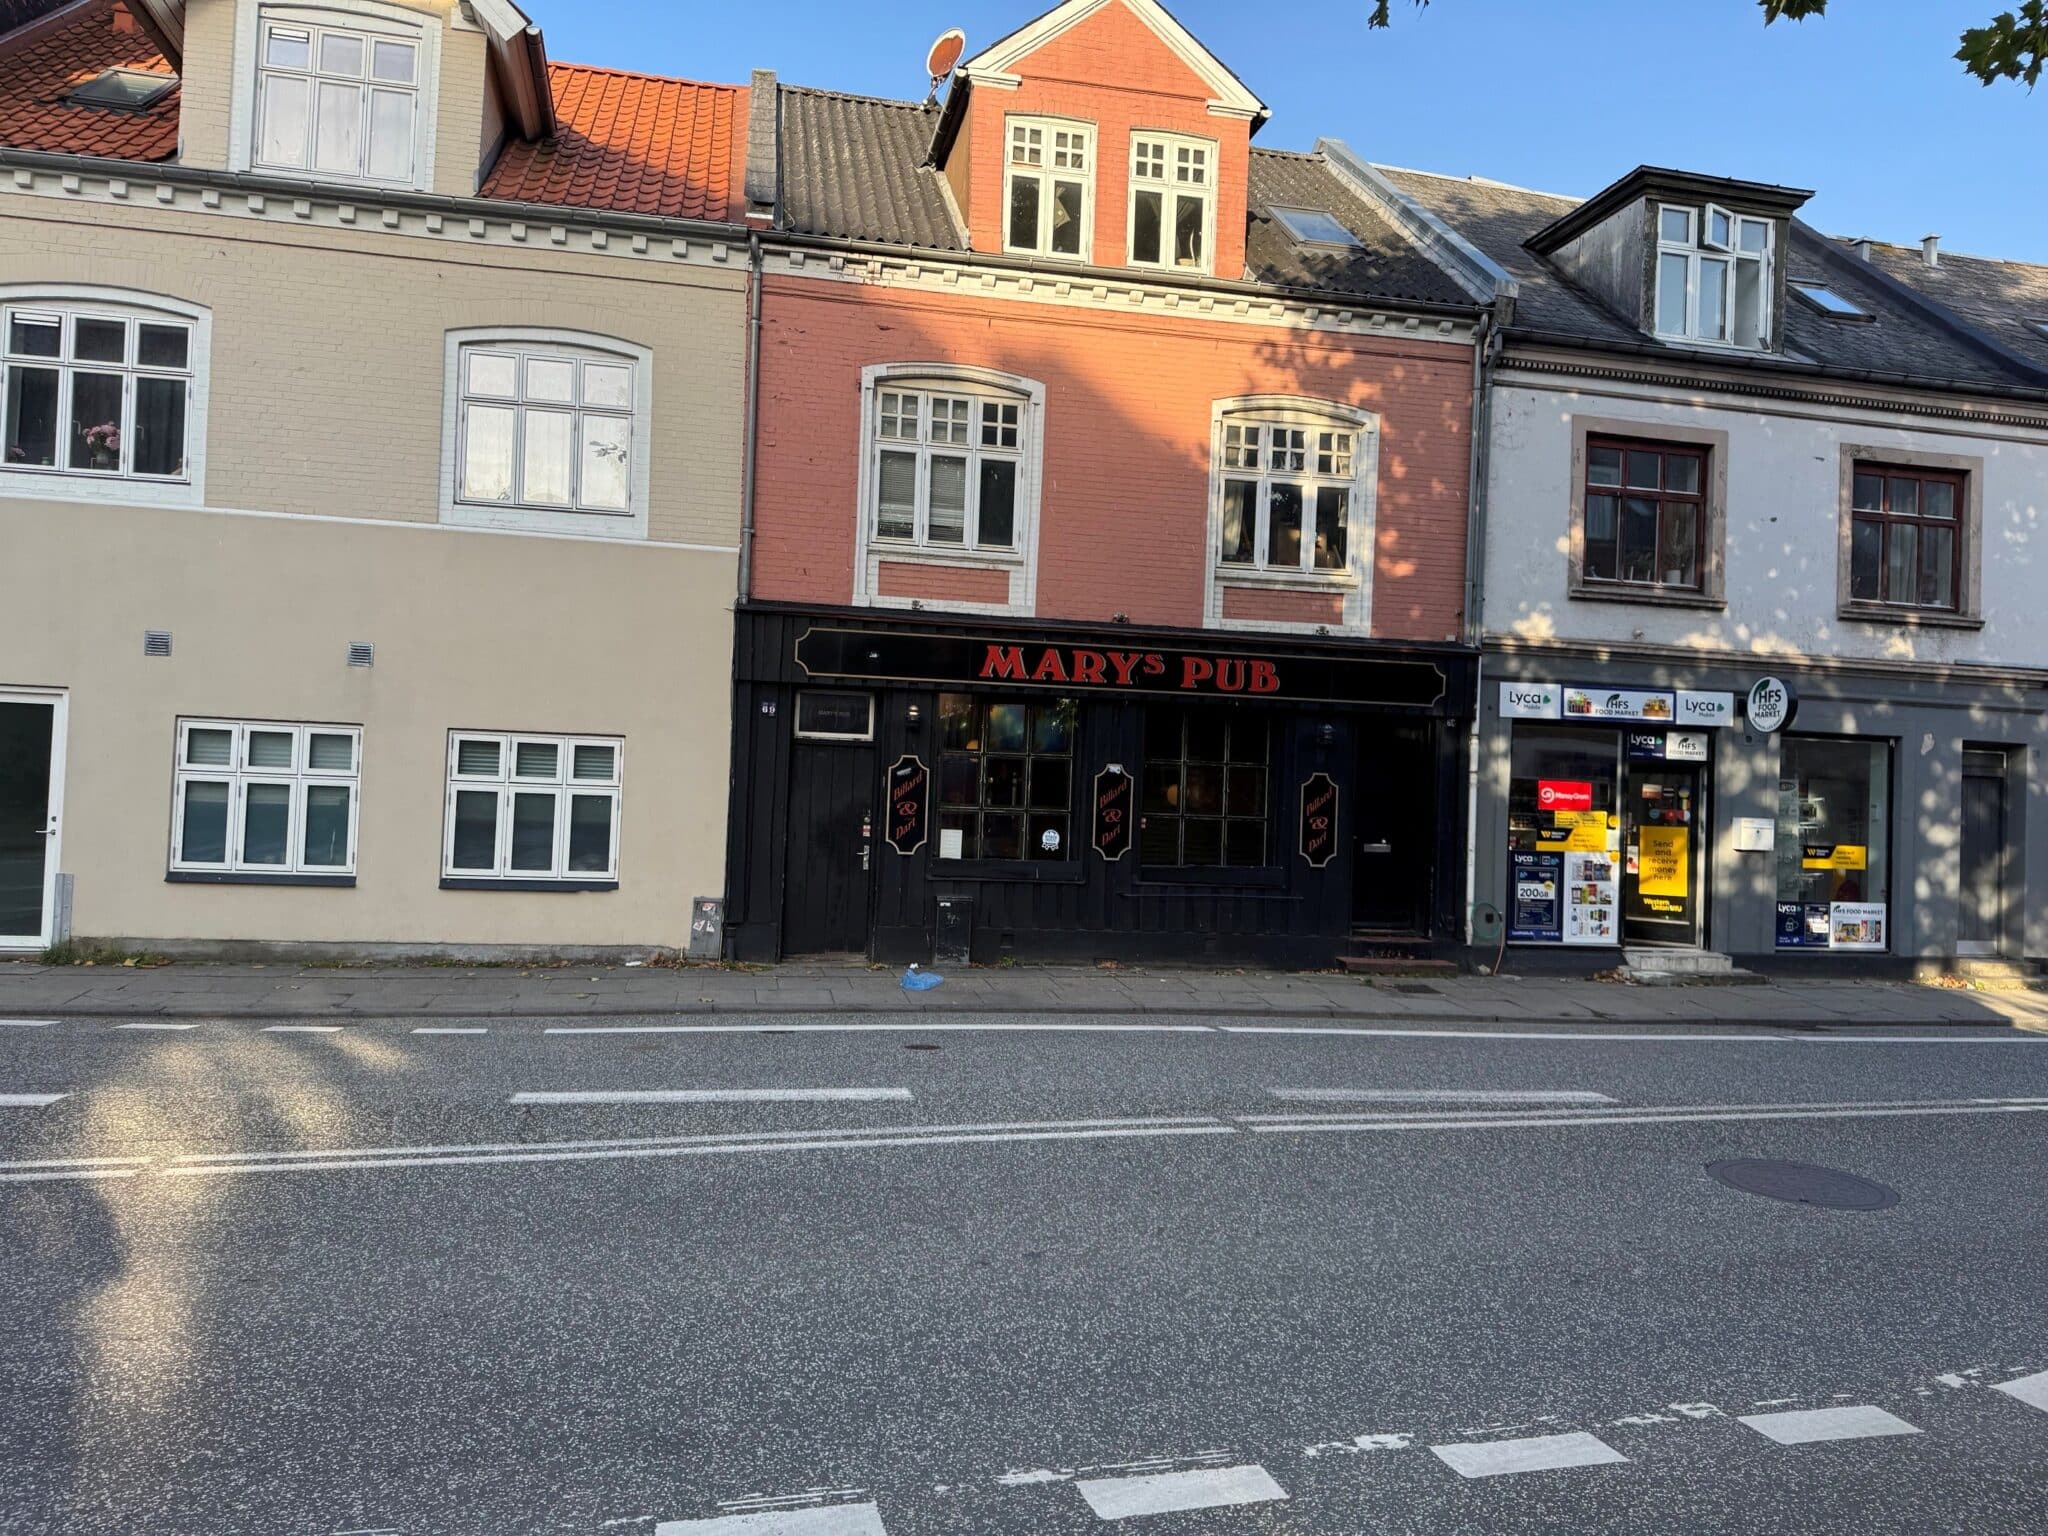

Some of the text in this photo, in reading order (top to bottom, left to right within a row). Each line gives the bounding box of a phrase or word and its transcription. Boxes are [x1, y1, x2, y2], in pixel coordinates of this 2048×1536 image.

[1181, 656, 1281, 692] PUB
[1509, 690, 1541, 705] Lyca
[1758, 689, 1782, 703] HFS
[1610, 700, 1629, 709] HFS
[1685, 699, 1715, 713] Lyca
[1758, 703, 1777, 711] FOOD
[1754, 710, 1781, 719] MARKET
[1630, 733, 1655, 745] Lyca
[893, 770, 923, 801] Billard
[1099, 778, 1128, 809] Billard
[896, 801, 918, 816] &
[1306, 786, 1333, 817] Billard
[1102, 808, 1122, 823] &
[895, 817, 916, 840] Dart
[1309, 816, 1329, 830] &
[1101, 823, 1121, 847] Dart
[1308, 831, 1327, 854] Dart
[1653, 840, 1674, 848] Send
[1514, 854, 1534, 863] Lyca
[1648, 857, 1679, 865] receive
[1648, 867, 1677, 875] money
[1778, 903, 1796, 913] Lyca
